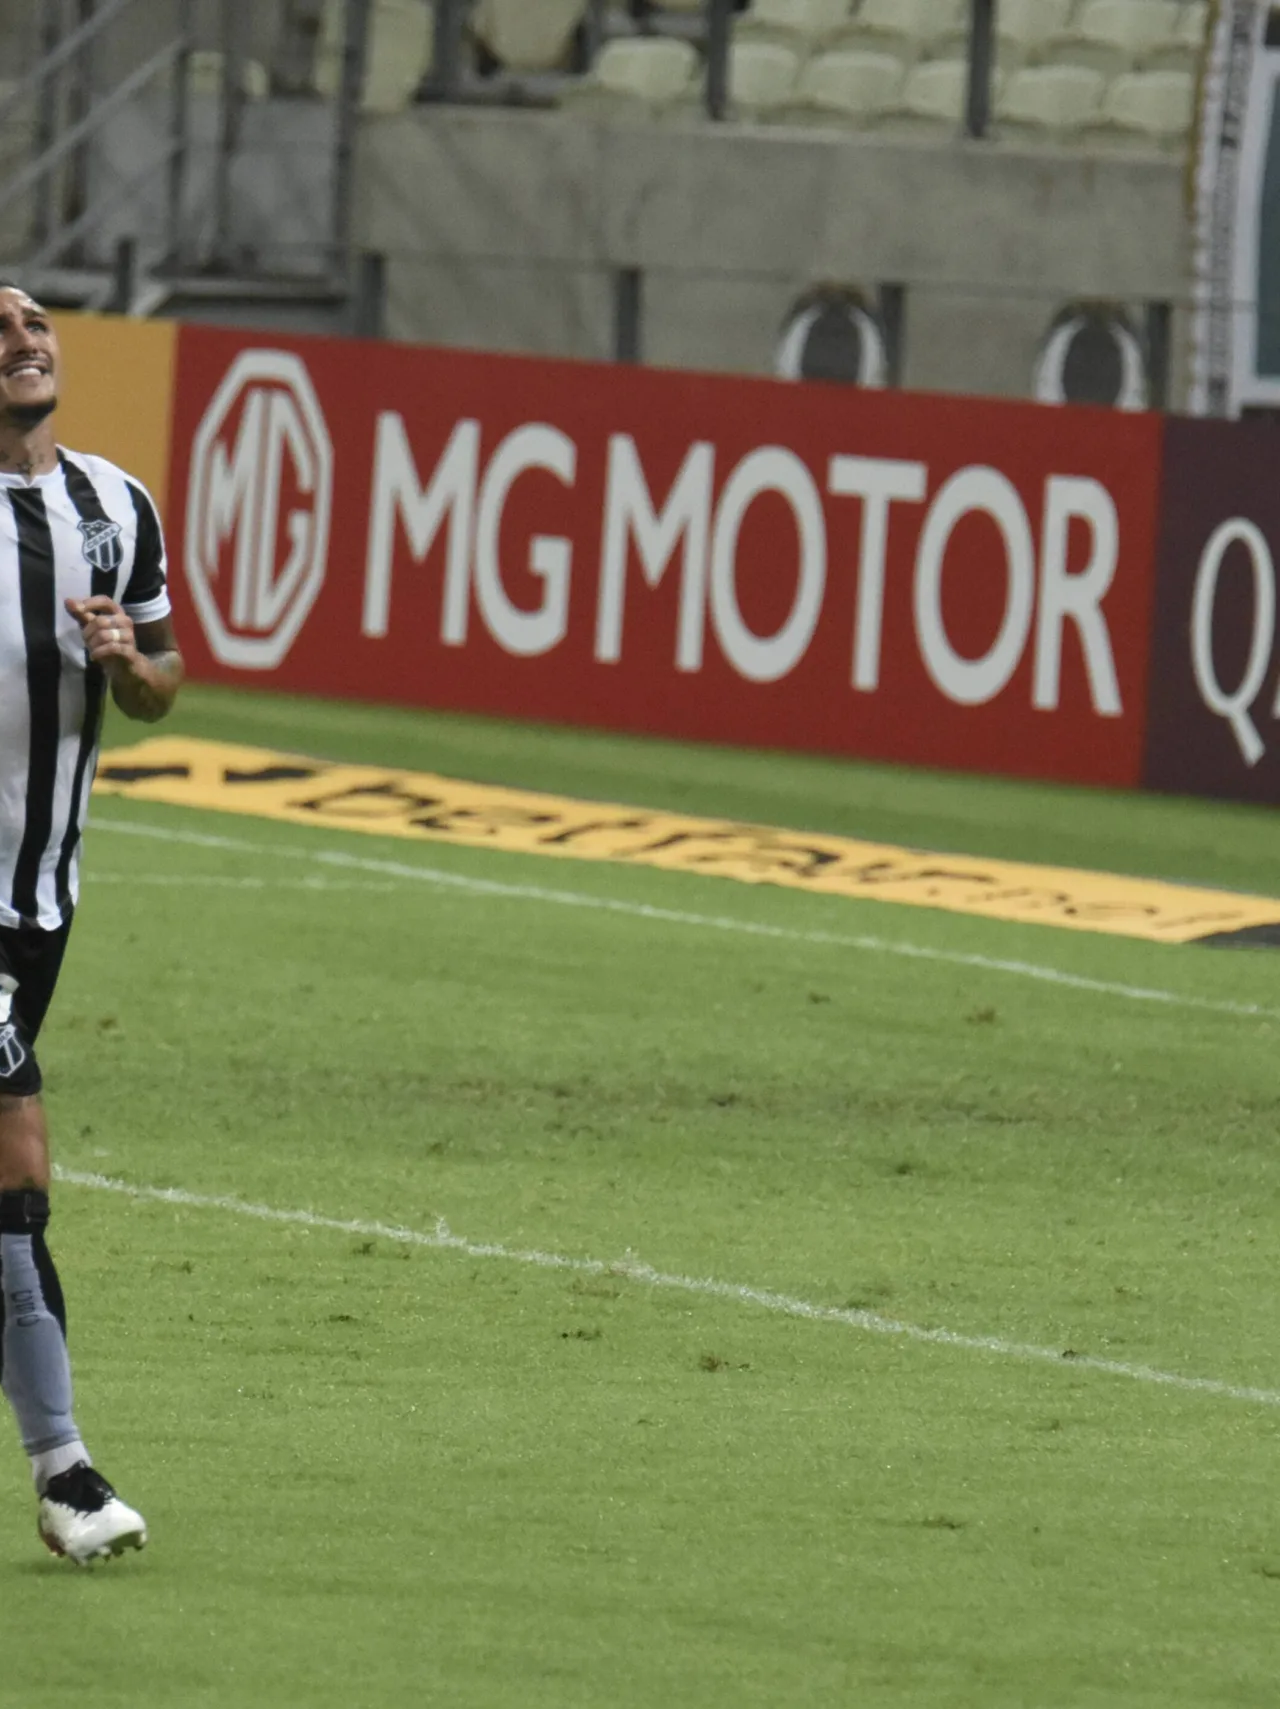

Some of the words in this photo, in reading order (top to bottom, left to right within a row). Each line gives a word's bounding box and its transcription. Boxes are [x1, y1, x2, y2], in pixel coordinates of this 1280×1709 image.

[207, 387, 315, 631] MG
[362, 409, 577, 657] MG
[594, 432, 1123, 717] MOTOR
[1190, 516, 1280, 767] Q
